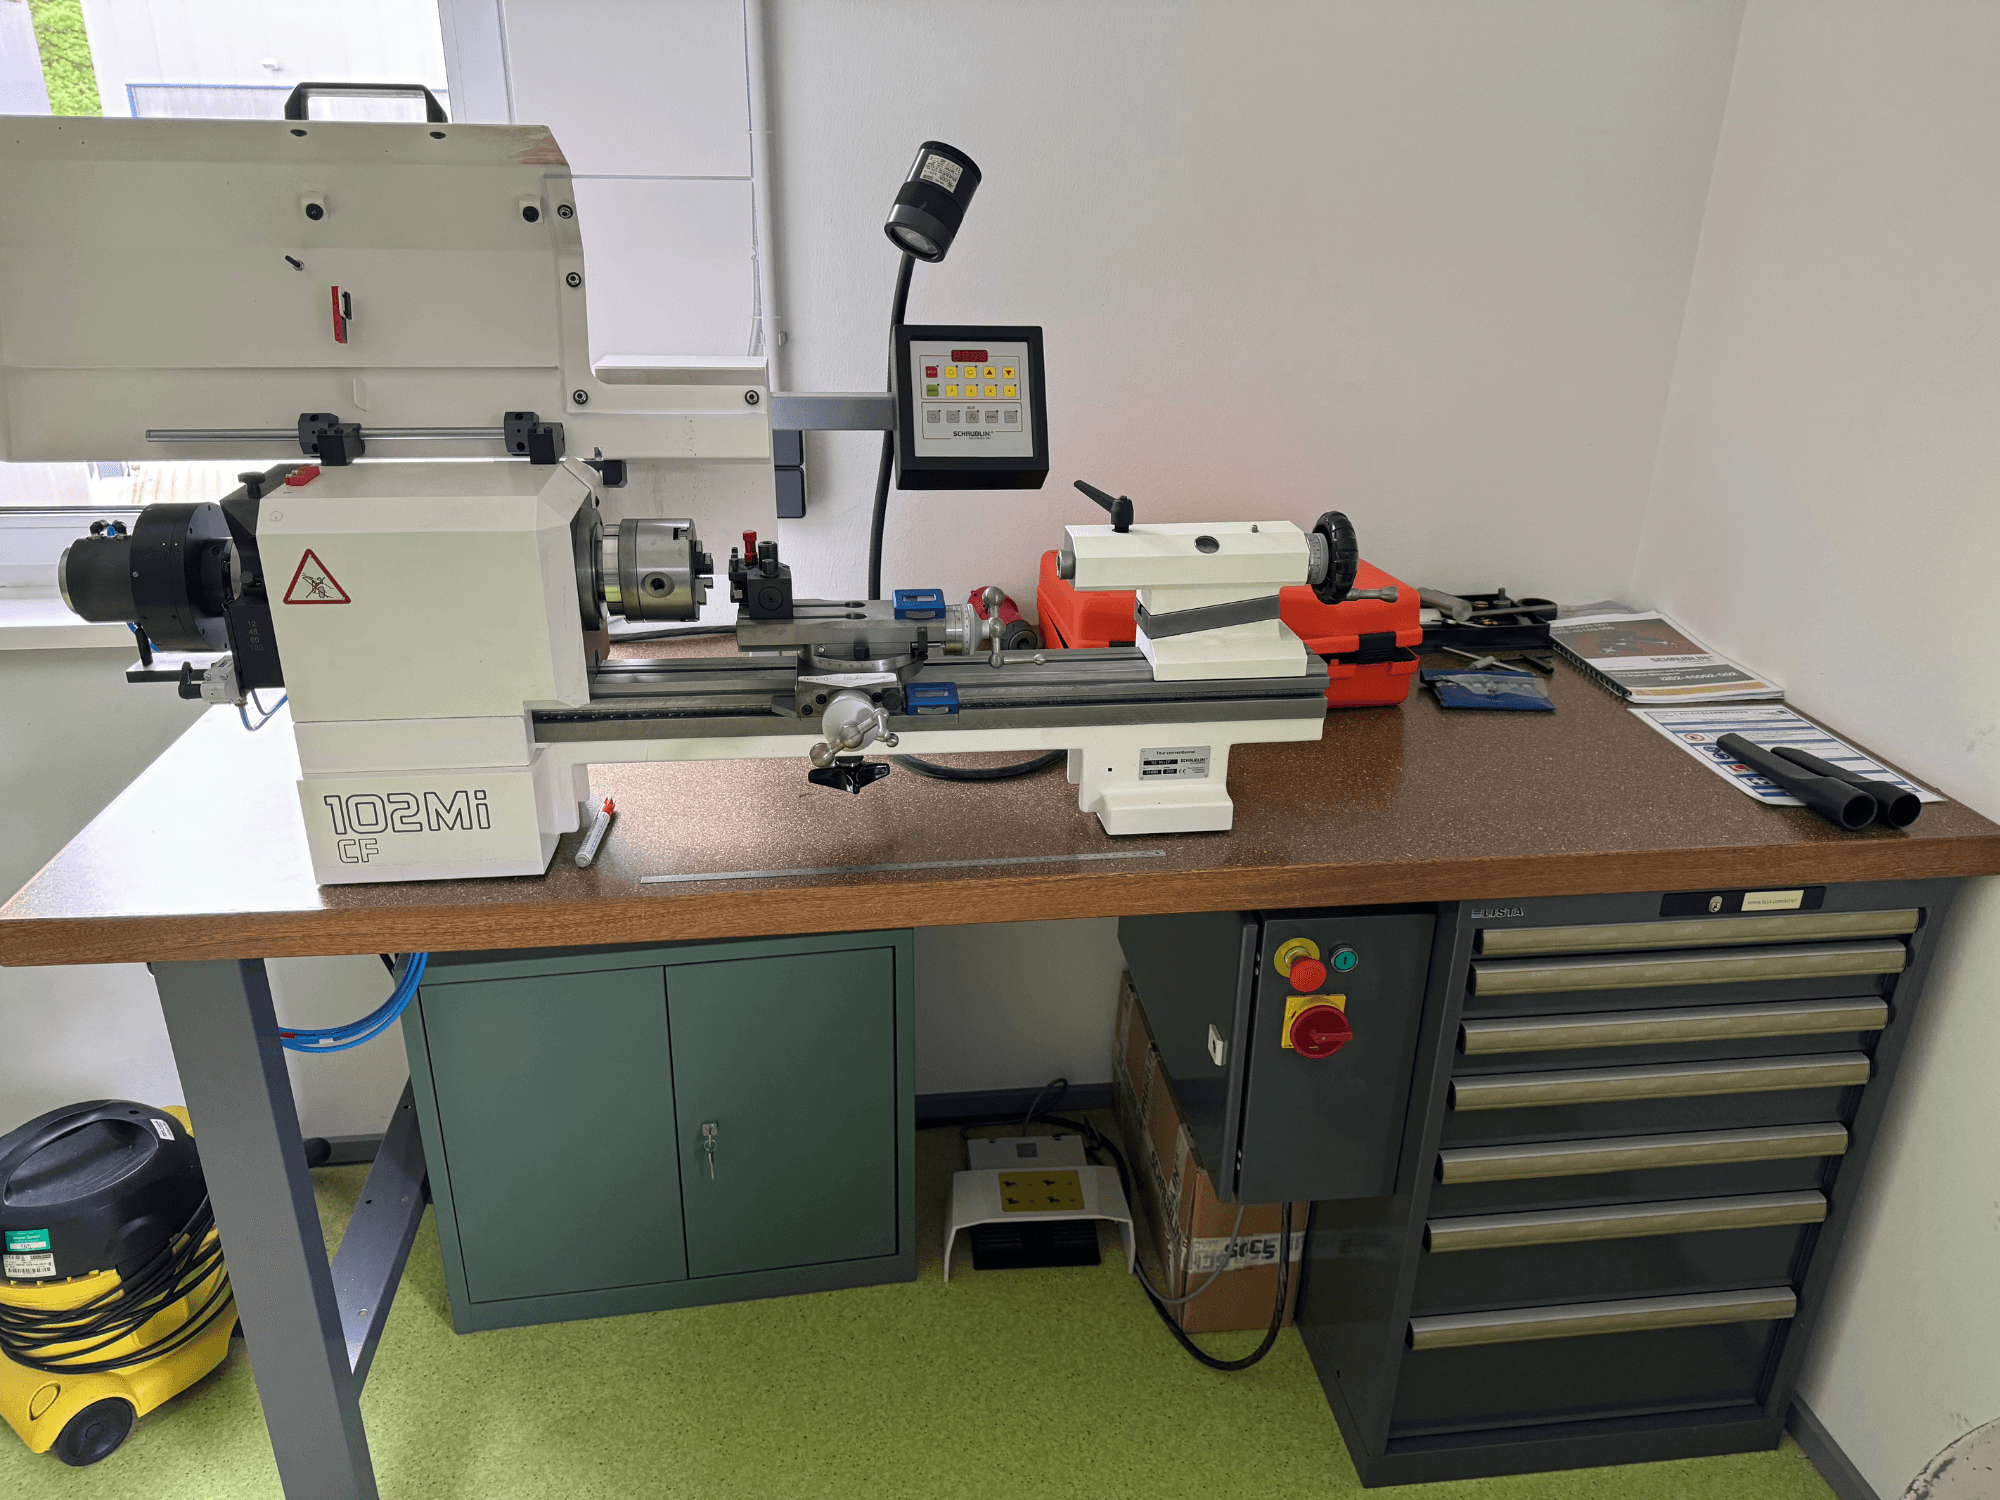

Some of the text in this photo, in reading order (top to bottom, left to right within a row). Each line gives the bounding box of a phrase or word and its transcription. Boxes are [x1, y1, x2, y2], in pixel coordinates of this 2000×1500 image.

[323, 789, 491, 835] 102Mi
[337, 838, 379, 864] CF
[1481, 907, 1524, 918] LISTA
